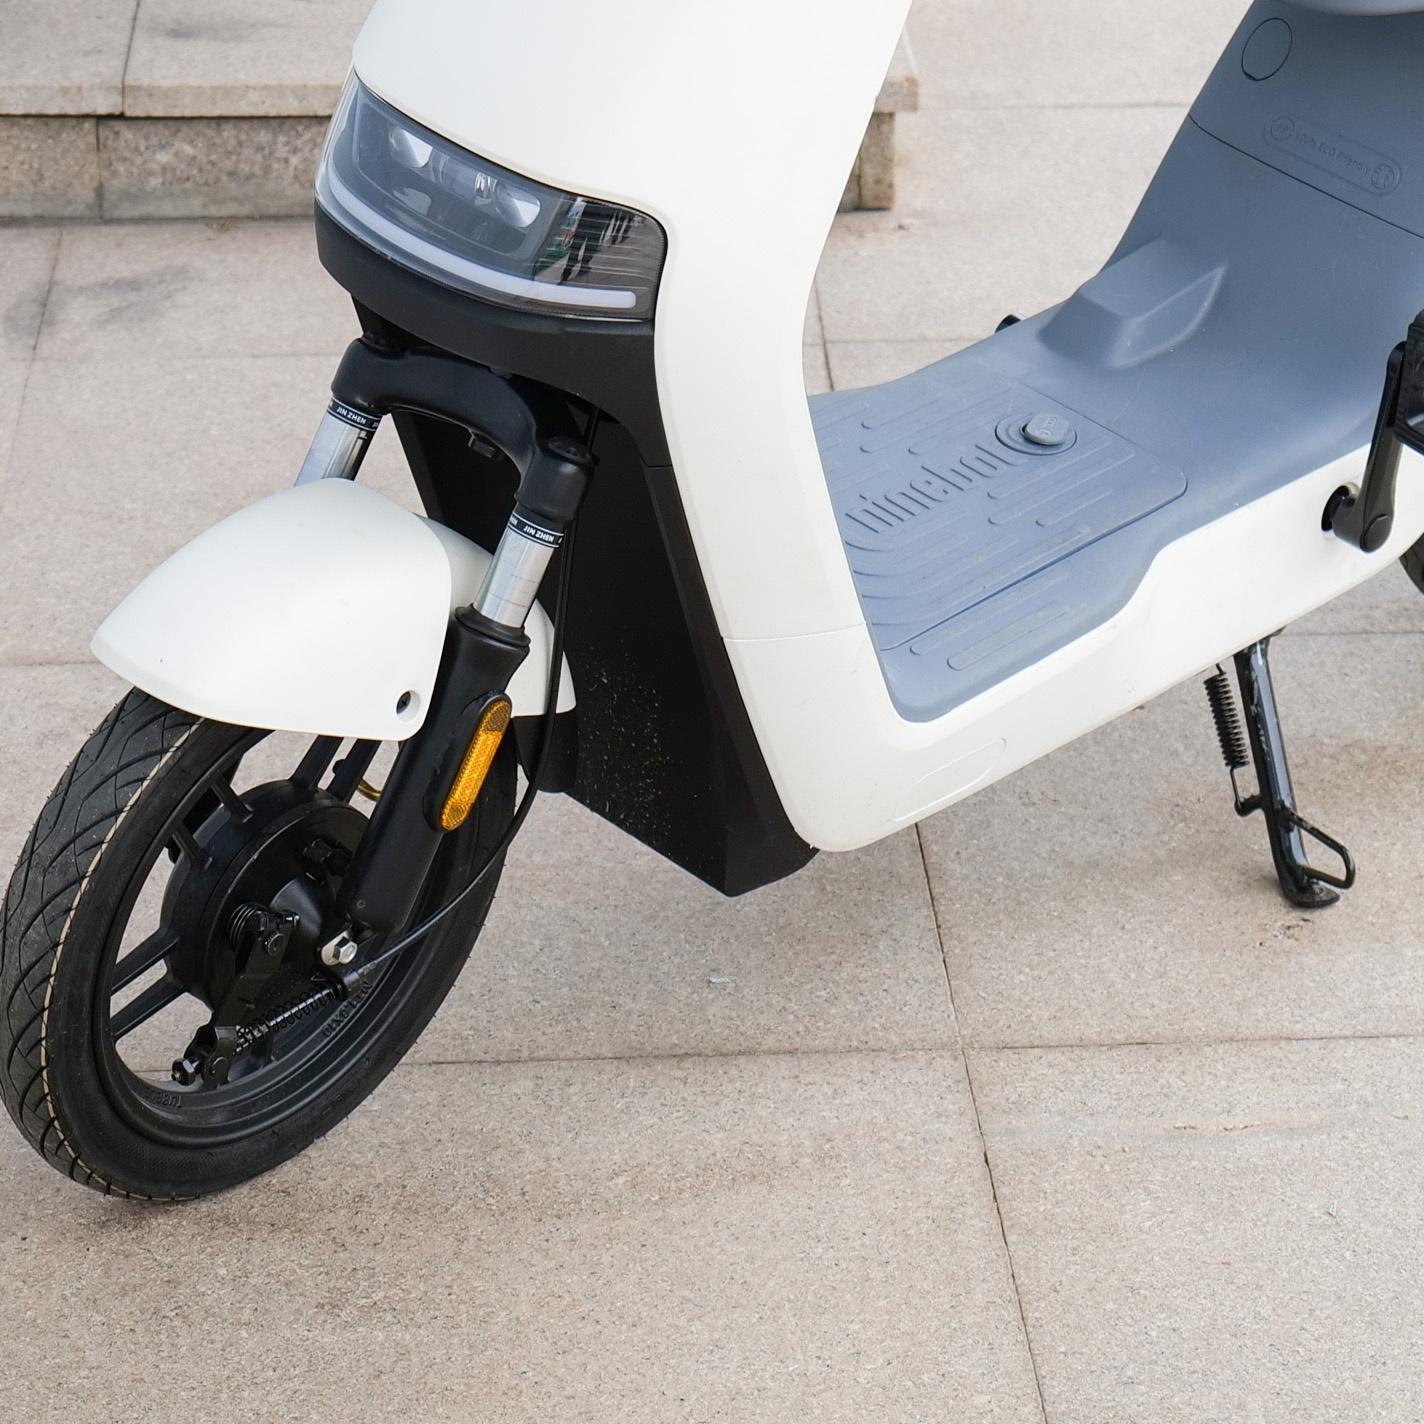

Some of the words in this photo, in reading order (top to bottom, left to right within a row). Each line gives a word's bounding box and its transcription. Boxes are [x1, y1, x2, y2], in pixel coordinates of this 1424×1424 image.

[346, 412, 368, 425] ZHEN
[845, 440, 1022, 536] ninebot
[523, 525, 536, 537] JIN
[535, 531, 555, 544] ZHEN
